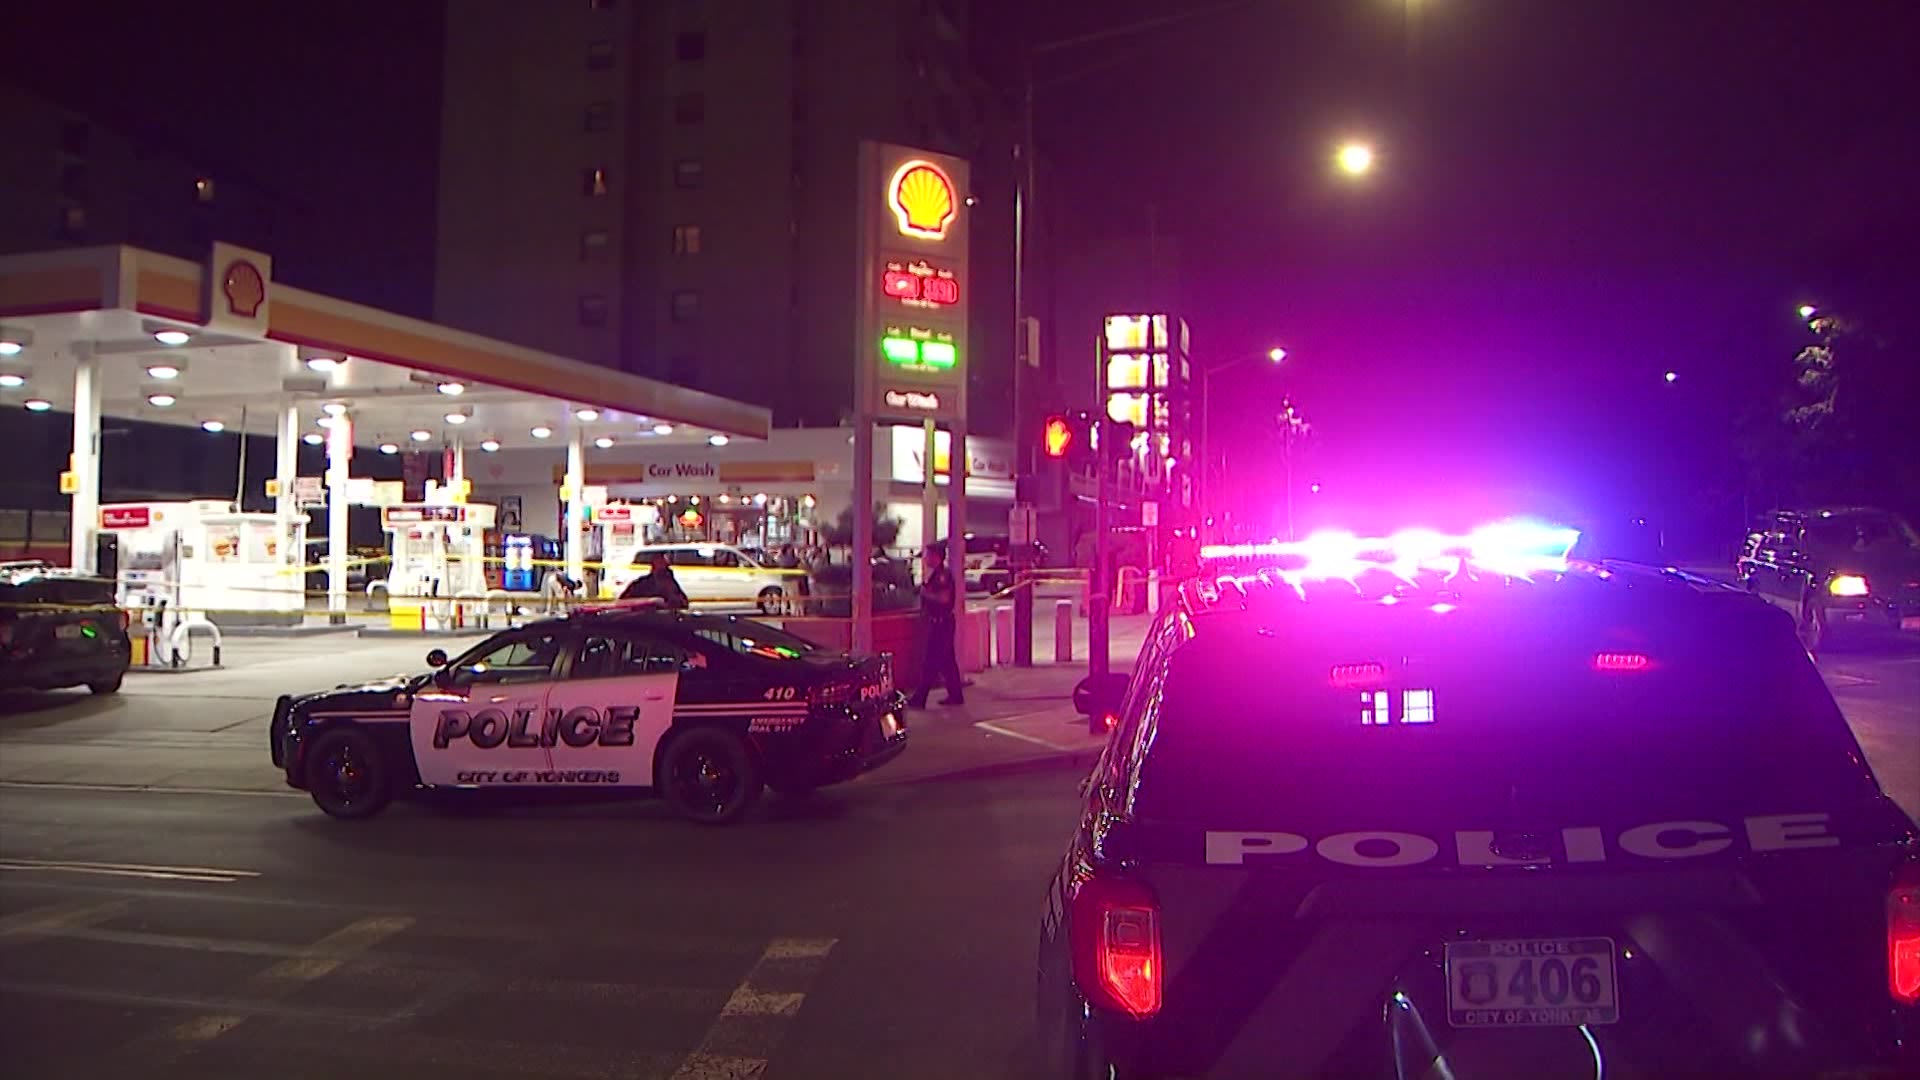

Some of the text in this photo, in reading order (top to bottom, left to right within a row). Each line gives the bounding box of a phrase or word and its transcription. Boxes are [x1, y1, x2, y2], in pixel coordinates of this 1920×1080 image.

[886, 391, 907, 407] Car
[648, 462, 714, 477] Car Wash
[764, 686, 796, 700] 410
[433, 705, 640, 749] POLICE
[774, 724, 793, 732] 911
[457, 770, 620, 783] CITY OF YONKERS
[1206, 813, 1840, 867] POLICE
[1490, 942, 1569, 957] POLICE
[1508, 957, 1601, 1005] 406
[1465, 1011, 1501, 1024] CITY
[1504, 1010, 1525, 1024] OF
